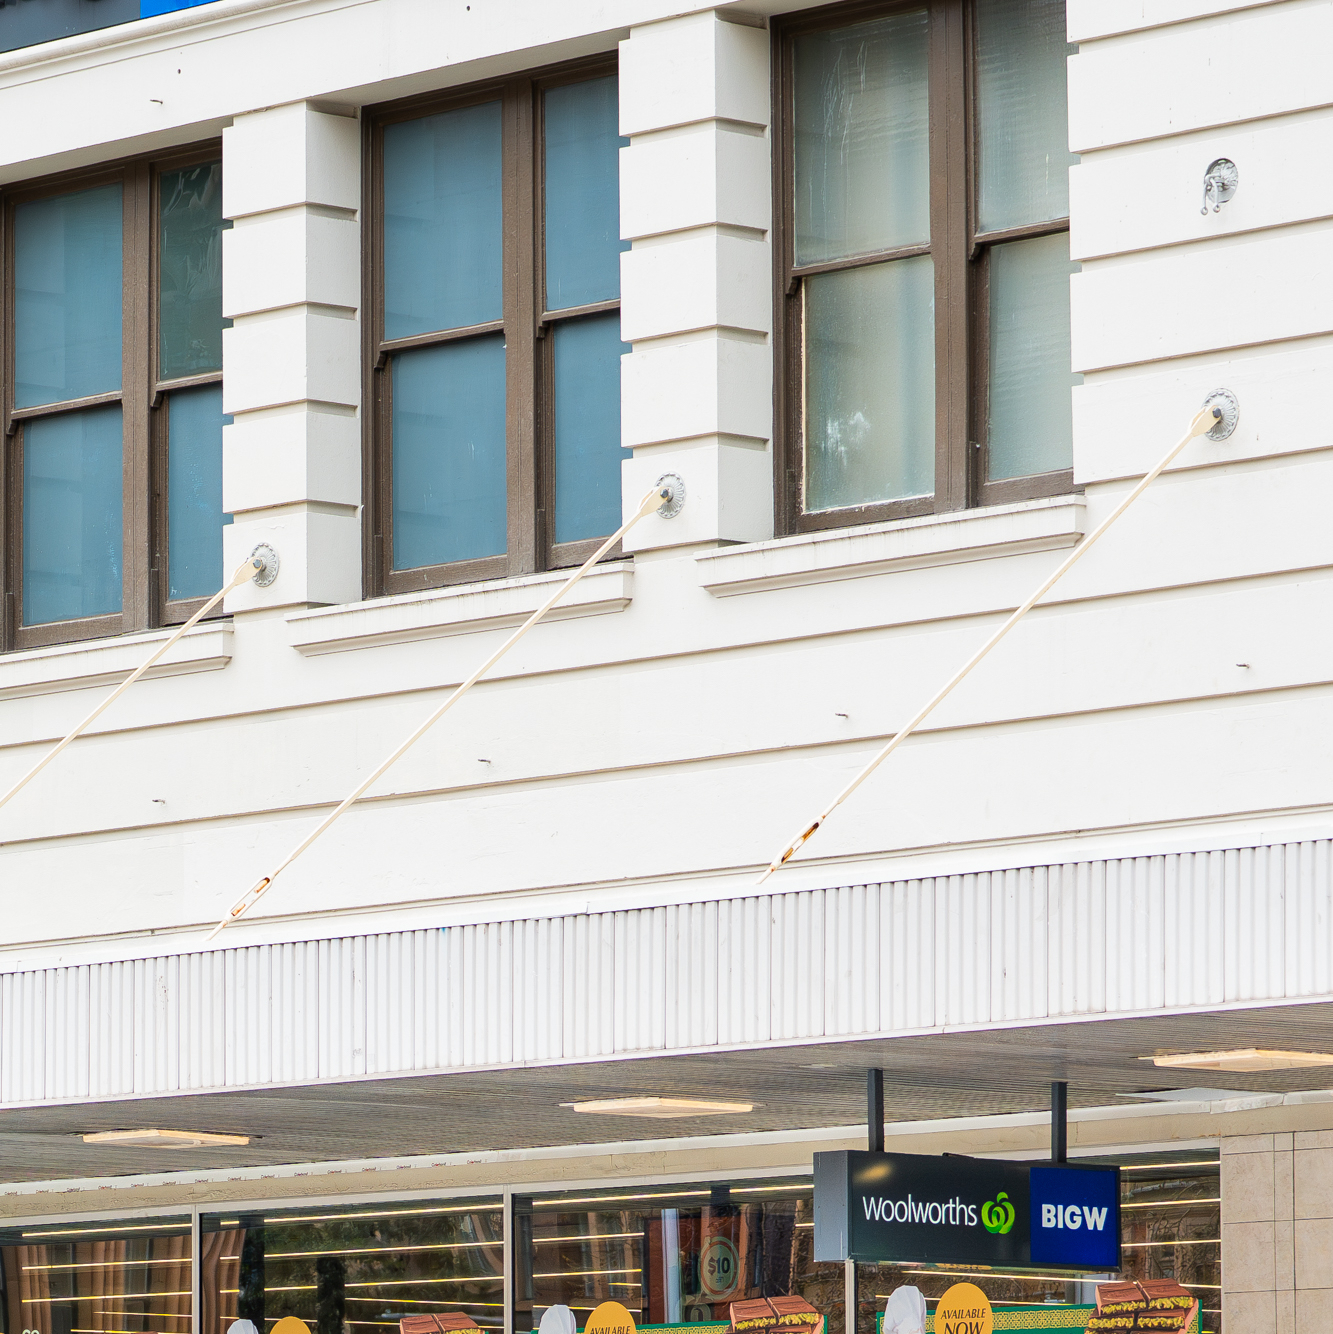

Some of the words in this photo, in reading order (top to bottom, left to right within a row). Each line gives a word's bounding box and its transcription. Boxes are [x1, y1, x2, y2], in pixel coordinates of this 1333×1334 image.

[863, 1194, 977, 1226] Woolworths
[1042, 1204, 1107, 1231] BIGW
[708, 1257, 730, 1275] $10
[941, 1308, 986, 1320] AVAILABLE
